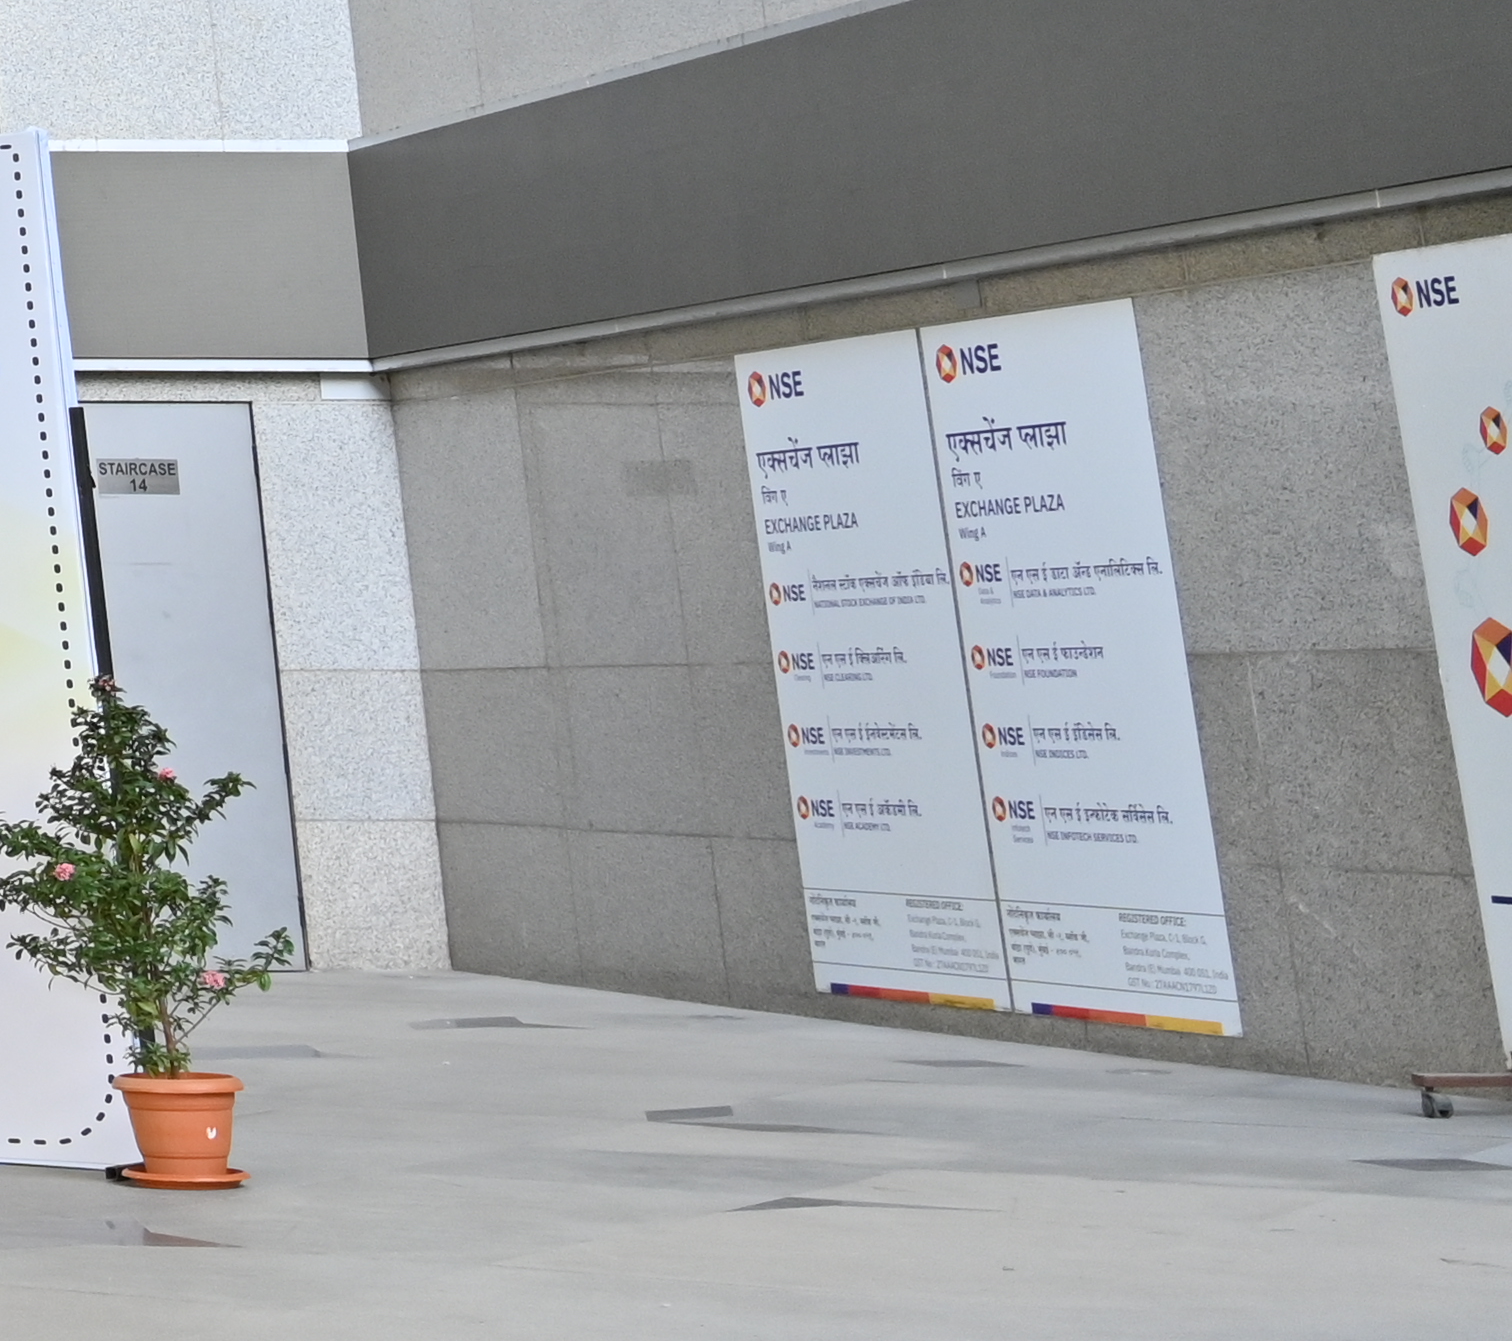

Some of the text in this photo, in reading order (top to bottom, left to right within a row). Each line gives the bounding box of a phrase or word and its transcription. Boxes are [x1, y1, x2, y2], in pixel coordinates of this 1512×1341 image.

[1415, 276, 1459, 308] NSE
[960, 343, 1002, 375] NSE
[768, 371, 804, 400] NSE
[946, 416, 1067, 462] एक्सचेंज प्लाझा
[756, 436, 860, 479] एक्सचेंज प्लाझा
[98, 462, 176, 476] STAIRCASE
[129, 478, 148, 492] 14
[973, 472, 983, 489] ए
[955, 494, 1065, 518] EXCHANGE PLAZA
[764, 512, 859, 535] EXCHANGE PLAZA
[959, 527, 987, 541] Wing A
[768, 540, 792, 555] Wing A
[975, 563, 1002, 583] NSE
[782, 584, 806, 602] NSE
[791, 653, 815, 670] NSE
[987, 647, 1014, 667] NSE
[801, 727, 825, 745] NSE
[998, 727, 1025, 745] NSE
[810, 799, 835, 817] NSE
[1008, 800, 1035, 820] NSE
